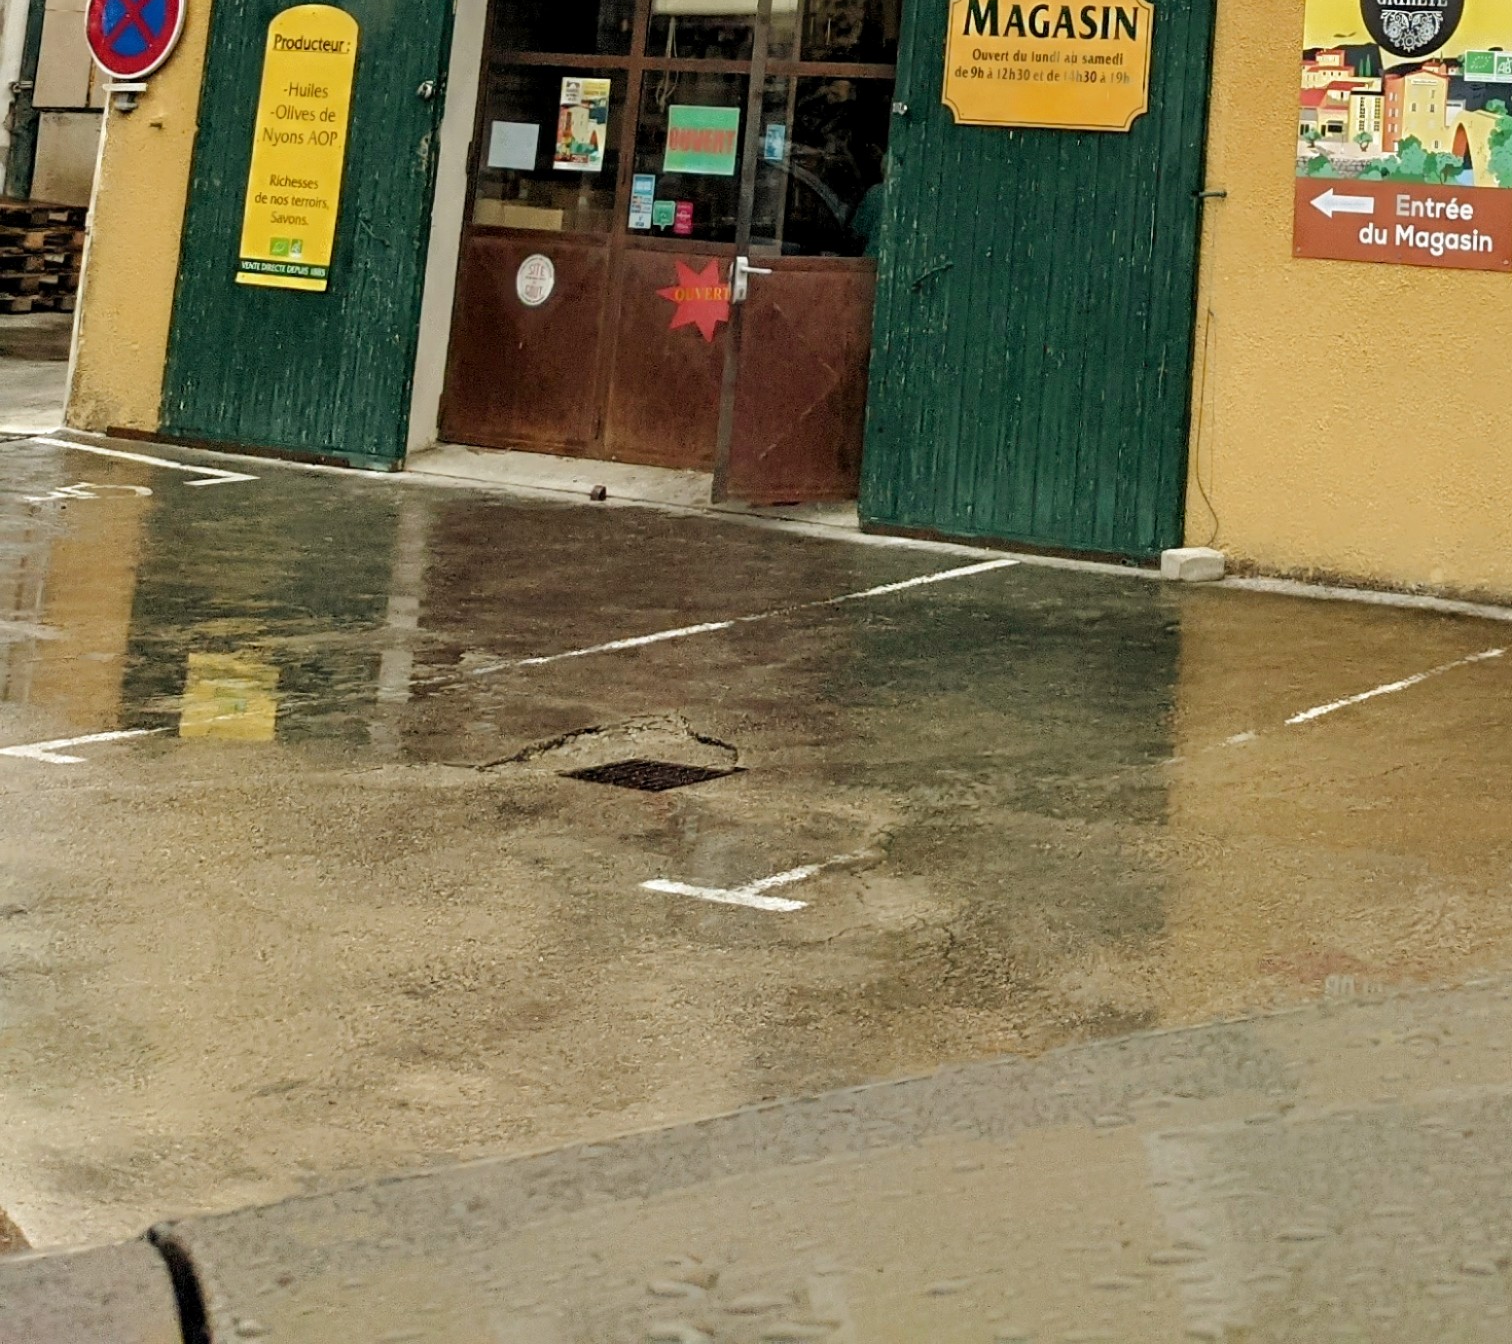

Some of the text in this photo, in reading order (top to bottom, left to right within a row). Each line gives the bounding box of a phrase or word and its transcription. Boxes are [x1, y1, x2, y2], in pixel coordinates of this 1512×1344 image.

[972, 48, 1124, 66] Ouvert du lundi au samedi
[954, 65, 969, 79] de
[970, 66, 984, 80] 9h
[986, 67, 993, 80] à
[997, 67, 1031, 81] 12h30
[1033, 70, 1044, 82] et
[1046, 70, 1060, 82] de
[1099, 72, 1106, 84] à
[1110, 71, 1130, 85] 19h
[319, 107, 337, 123] de
[262, 127, 338, 147] Nyons AOP
[269, 174, 319, 190] Richesses
[254, 192, 268, 205] de
[270, 195, 289, 207] nos
[1396, 194, 1474, 221] Entrée
[1358, 222, 1493, 257] du Magasin
